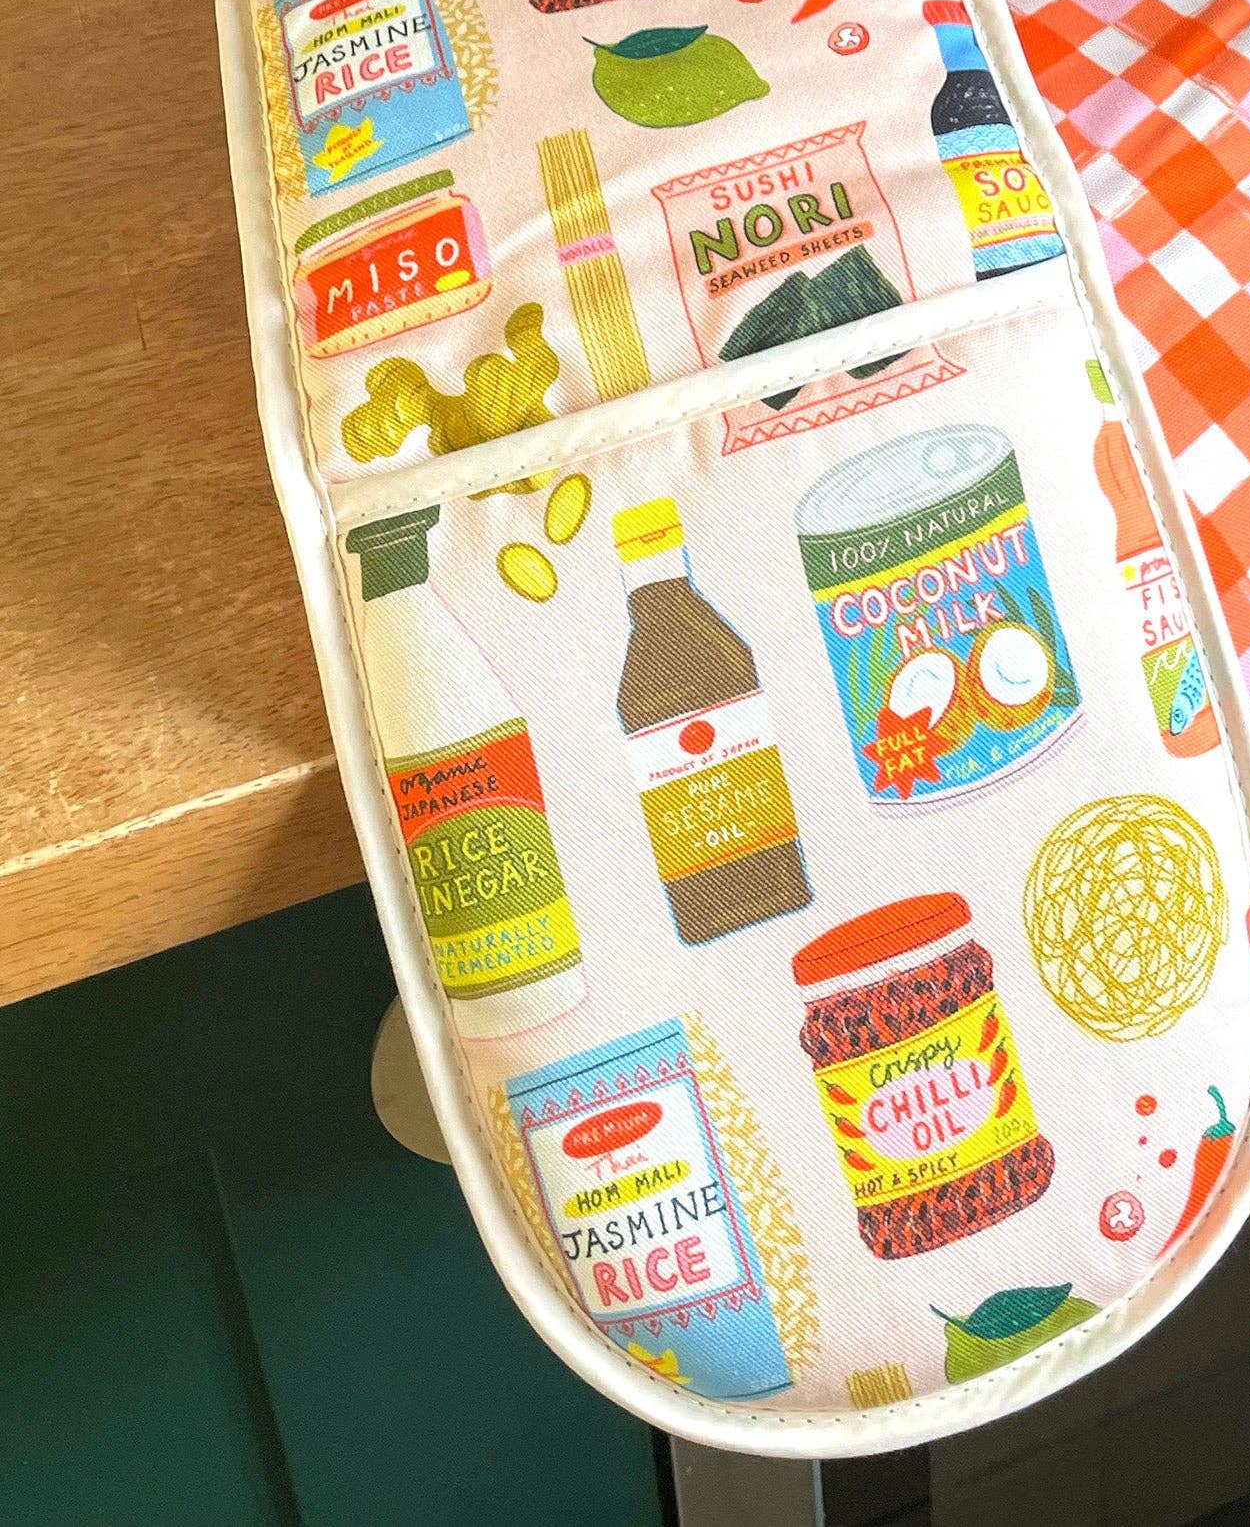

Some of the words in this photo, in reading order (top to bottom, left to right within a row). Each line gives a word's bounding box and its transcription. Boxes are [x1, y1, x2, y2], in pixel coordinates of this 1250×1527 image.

[293, 14, 431, 83] JASMINE
[312, 23, 349, 48] HOM
[361, 5, 401, 28] MALI
[314, 44, 413, 104] RICE
[710, 161, 814, 210] SUSHI
[974, 166, 1028, 197] SO
[689, 181, 854, 276] NORI
[978, 193, 1049, 224] SAUC
[327, 237, 460, 315] MISO
[709, 251, 790, 294] SEAWEED
[801, 226, 864, 257] SHEETS
[351, 283, 424, 323] PASTE
[829, 535, 892, 573] 100%
[903, 491, 1008, 547] NATURAL
[831, 522, 1030, 639] COCONUT
[1141, 576, 1182, 612] FIS
[895, 590, 1005, 660] MILK
[1142, 611, 1185, 647] SAU
[649, 761, 695, 782] PRODUCT
[722, 737, 761, 758] JAPAN
[876, 727, 927, 756] FULL
[884, 746, 927, 780] FAT
[402, 774, 500, 822] JAPANESE
[661, 779, 770, 836] SESAME
[688, 772, 731, 797] PURE
[415, 821, 512, 881] RICE
[420, 848, 552, 917] INEGAR
[435, 914, 551, 960] NATURALLY
[870, 1035, 962, 1090] Crispy
[866, 1061, 983, 1134] CHILLI
[911, 1110, 966, 1152] OIL
[575, 1181, 618, 1213] HOM
[635, 1160, 684, 1194] MALI
[854, 1176, 884, 1200] HOT
[909, 1152, 961, 1184] SPICY
[561, 1180, 728, 1261] JASMINE
[592, 1235, 711, 1308] RICE
